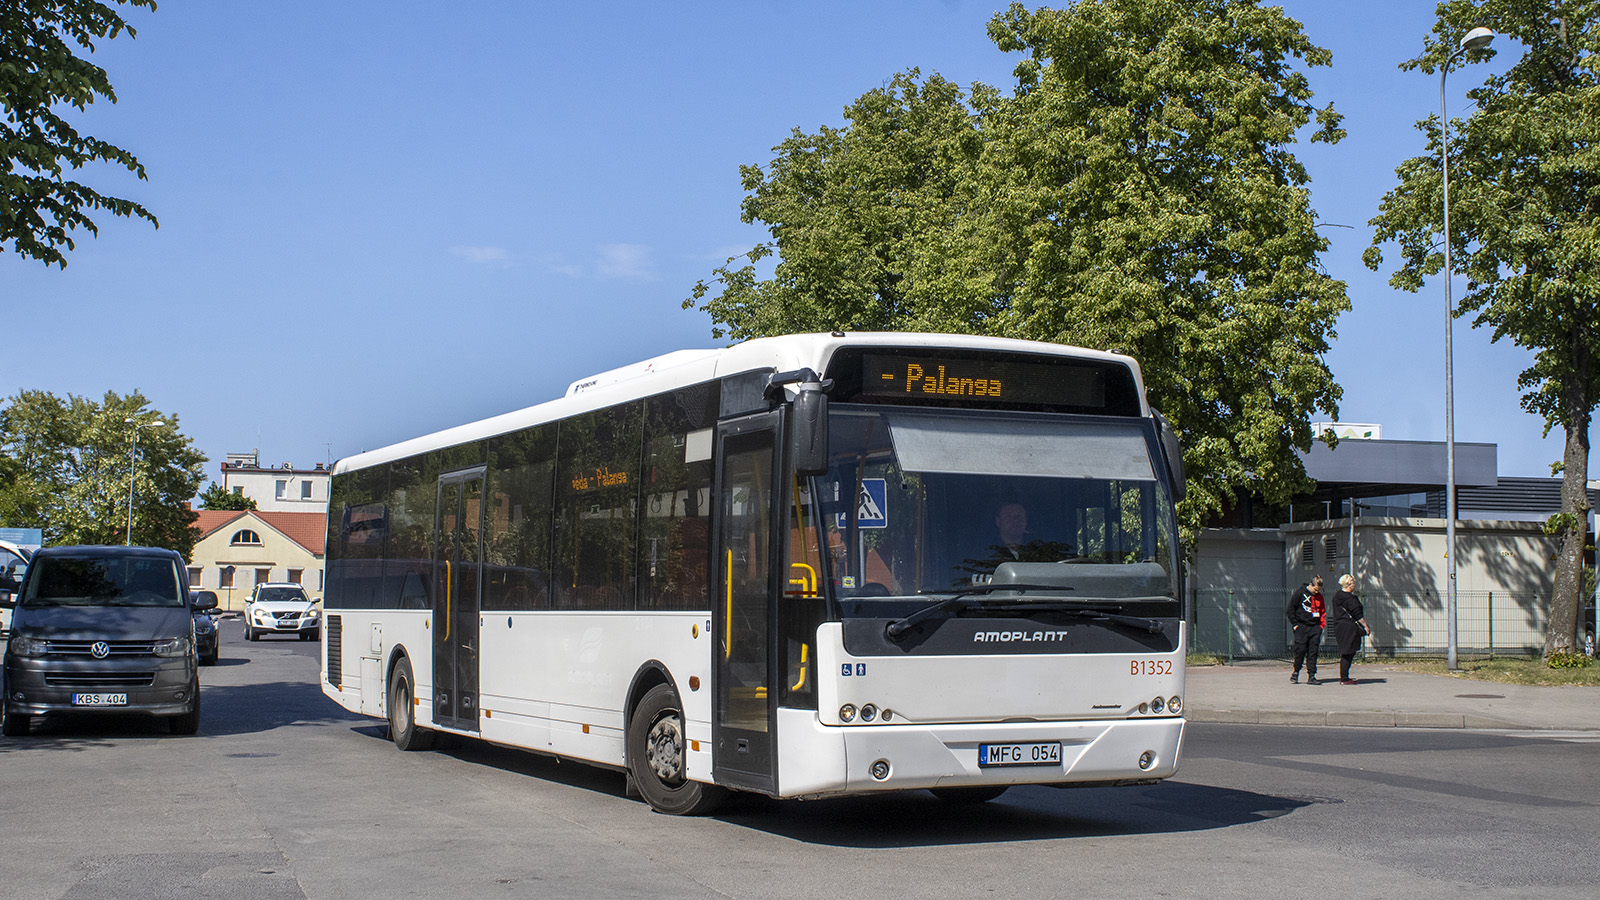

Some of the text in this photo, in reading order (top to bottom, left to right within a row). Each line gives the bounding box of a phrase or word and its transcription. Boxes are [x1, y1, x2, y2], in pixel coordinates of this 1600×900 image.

[906, 363, 1001, 397] Palanga
[596, 466, 628, 487] Palanga
[973, 631, 1068, 642] AMOPLANT
[1130, 660, 1173, 676] B1352
[77, 694, 126, 704] KBS 404
[989, 746, 1021, 761] MFG
[1031, 745, 1058, 760] 054
